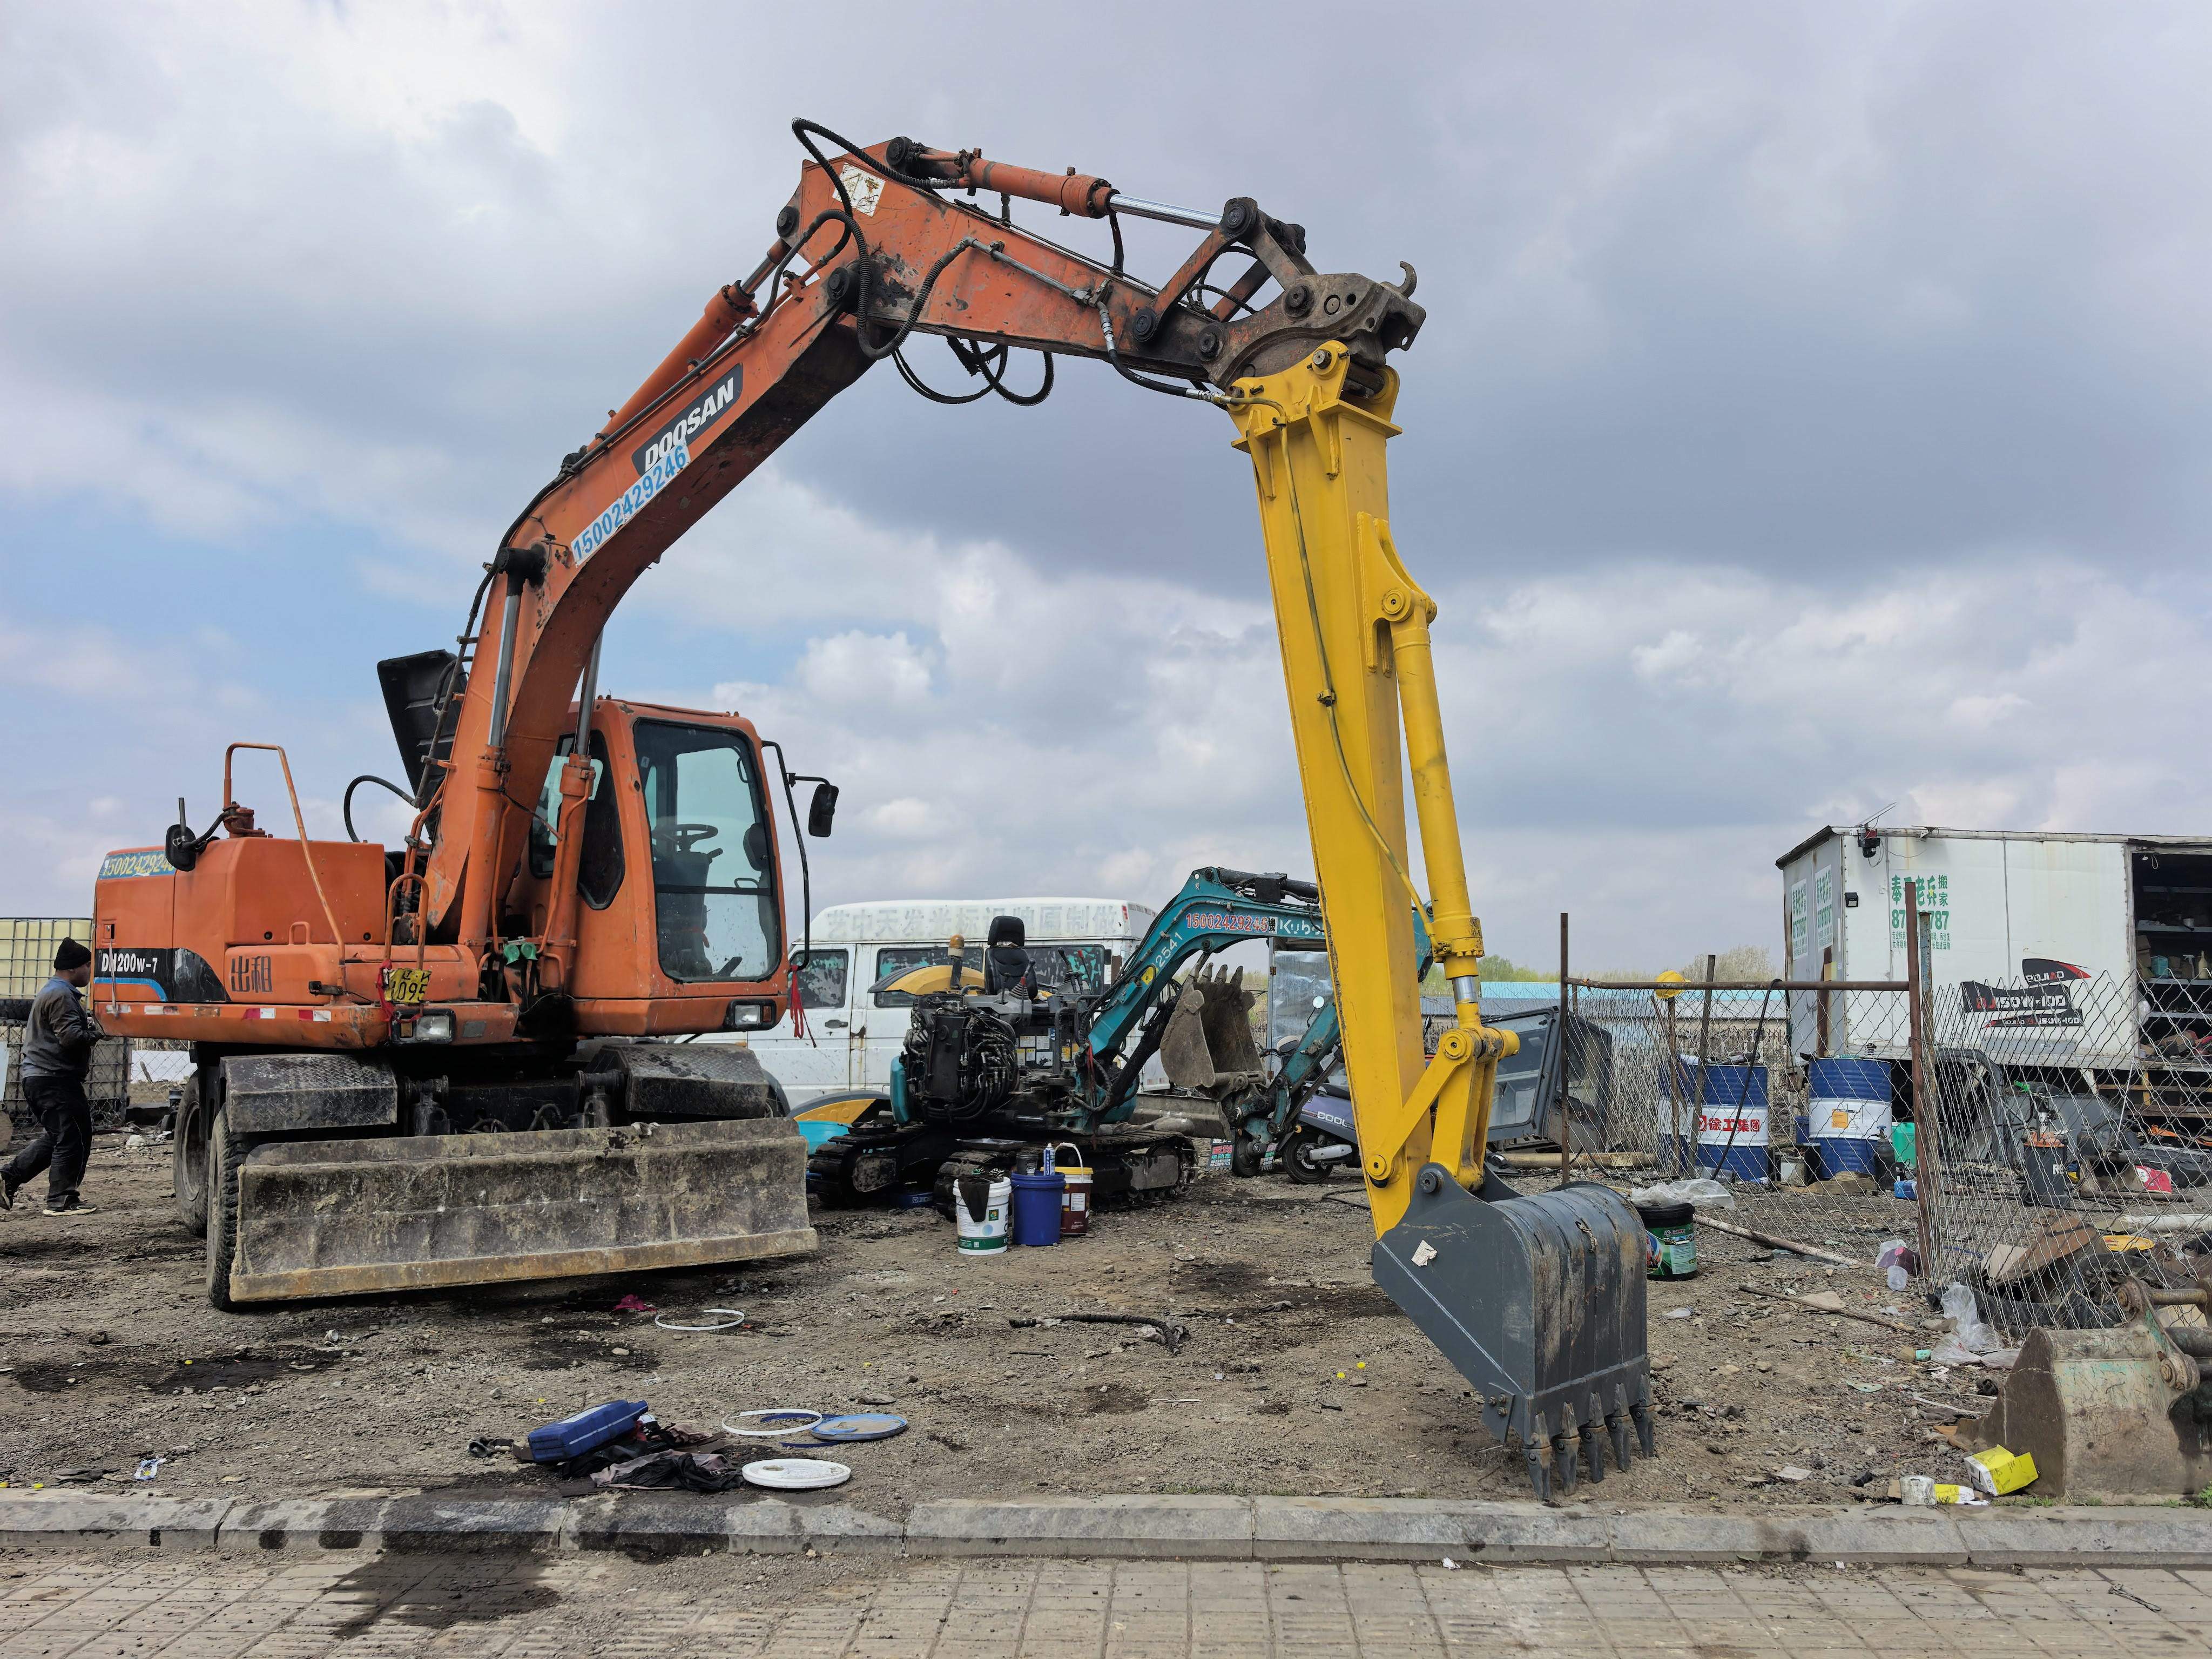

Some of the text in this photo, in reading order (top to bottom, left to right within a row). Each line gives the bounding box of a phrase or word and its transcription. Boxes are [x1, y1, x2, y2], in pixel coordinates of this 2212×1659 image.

[644, 377, 734, 472] DOOSAN
[572, 445, 686, 560] 15002429246
[1892, 874, 1937, 907] 奉老兵
[1939, 874, 1948, 907] 搬家
[1186, 913, 1269, 933] 15002429246
[1280, 919, 1324, 935] Kubo
[231, 955, 273, 993] 出租
[1709, 1117, 1760, 1132] 徐工集团
